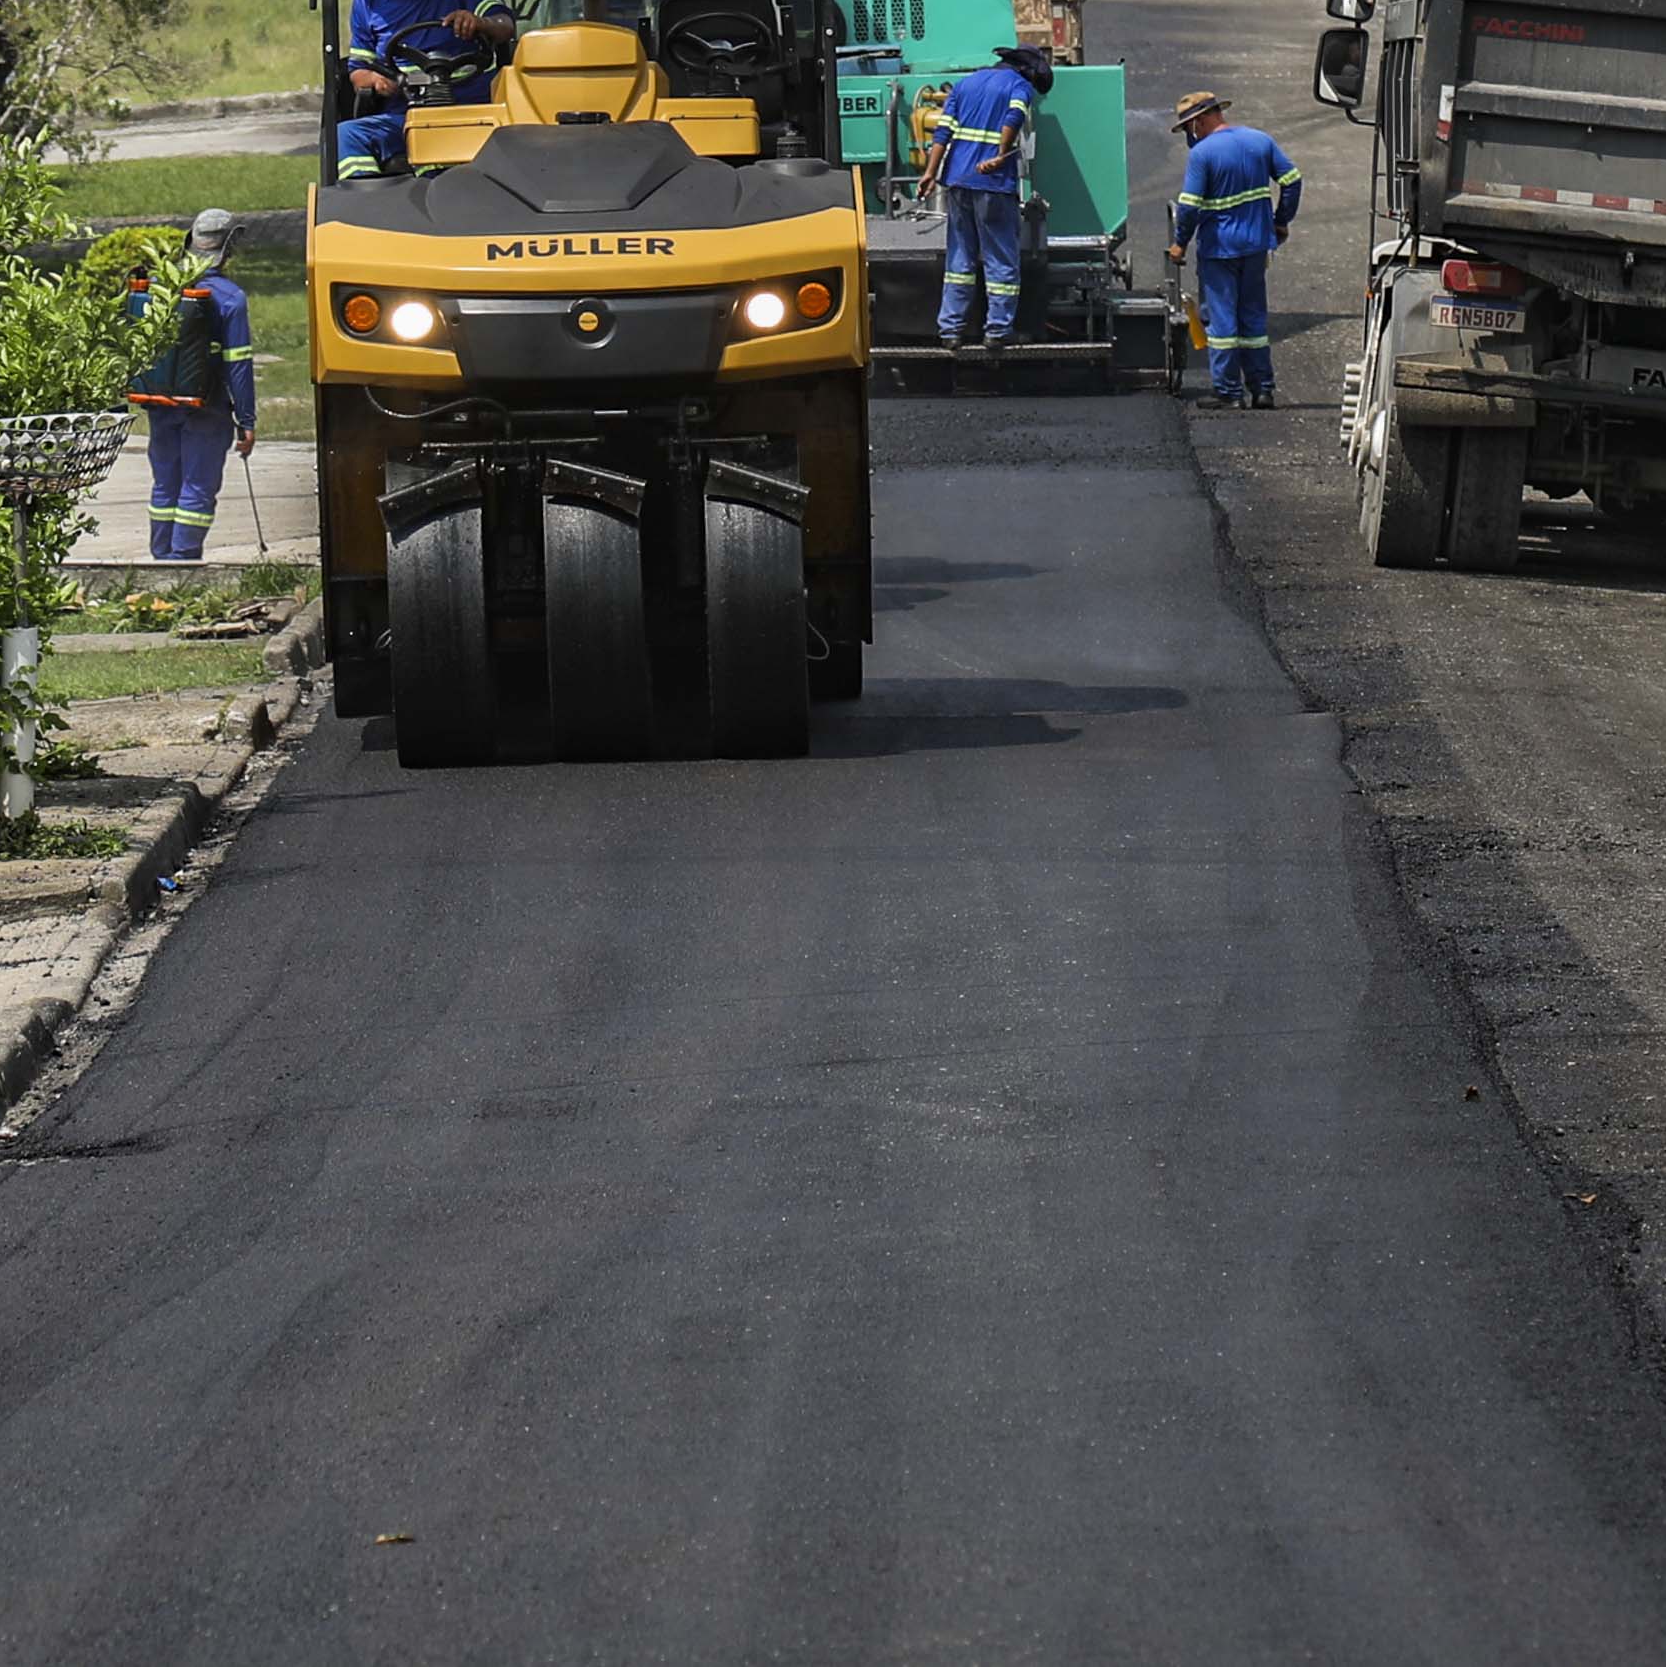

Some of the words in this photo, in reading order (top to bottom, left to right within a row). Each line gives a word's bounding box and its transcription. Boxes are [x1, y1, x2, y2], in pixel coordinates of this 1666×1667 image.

[1471, 15, 1586, 43] FACCHINI
[837, 96, 877, 112] IBER
[487, 237, 675, 261] MÜLLER
